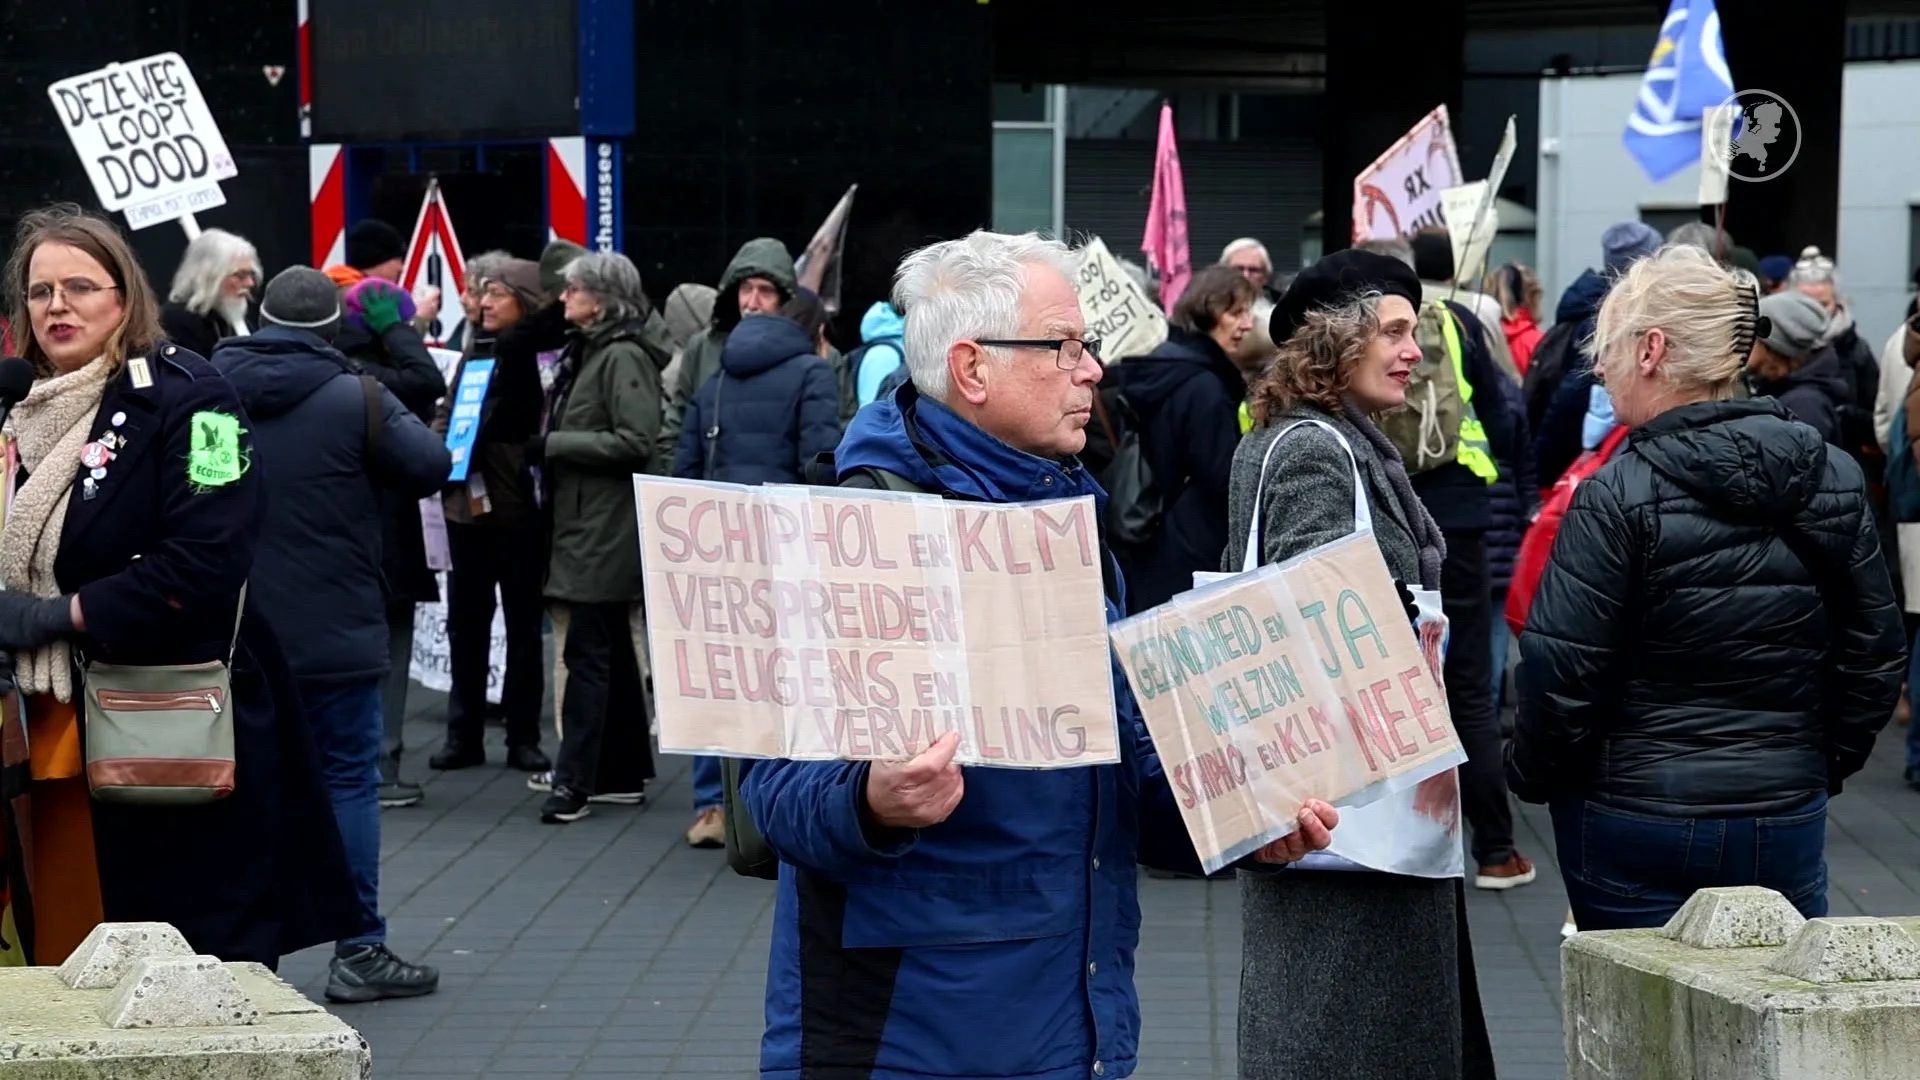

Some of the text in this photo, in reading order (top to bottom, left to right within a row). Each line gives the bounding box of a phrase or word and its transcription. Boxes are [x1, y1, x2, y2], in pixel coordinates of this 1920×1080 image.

[56, 60, 186, 127] DEZE WEG
[98, 99, 194, 151] LOOPT
[97, 134, 209, 199] DOOD
[656, 496, 1094, 575] SCHIPHOL EN KLM
[667, 574, 958, 642] VERSPREIDEN
[1263, 612, 1291, 643] EN
[1300, 589, 1389, 679] JA
[674, 639, 957, 708] LEUGENS EN
[1341, 665, 1447, 772] NEE
[1257, 741, 1285, 771] EN
